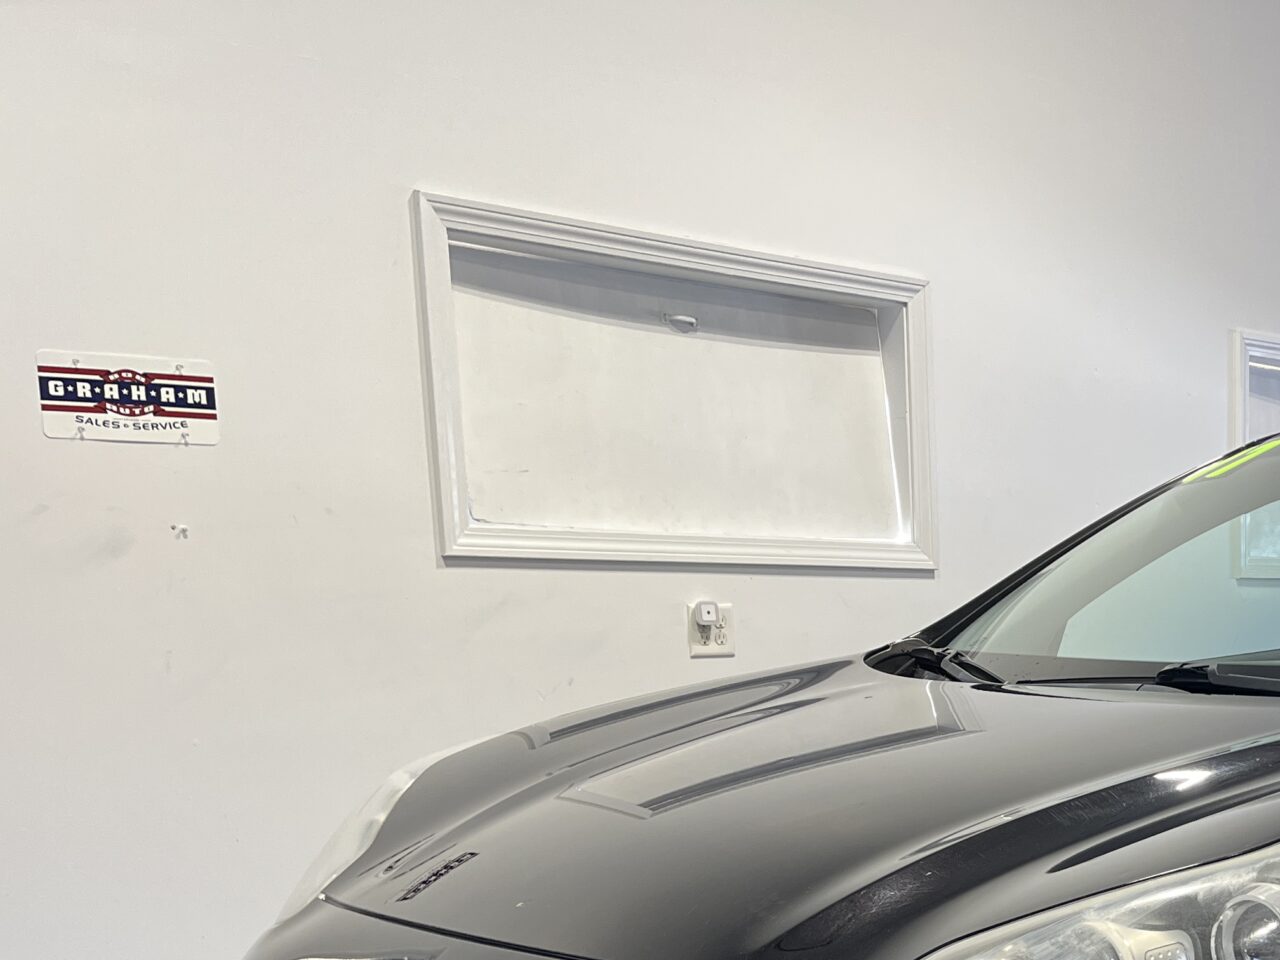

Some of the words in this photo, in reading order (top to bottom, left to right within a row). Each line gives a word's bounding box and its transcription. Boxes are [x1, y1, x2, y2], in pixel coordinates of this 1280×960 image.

[105, 402, 154, 416] AUTO
[74, 415, 121, 430] SALES
[132, 420, 189, 431] SERVICE
